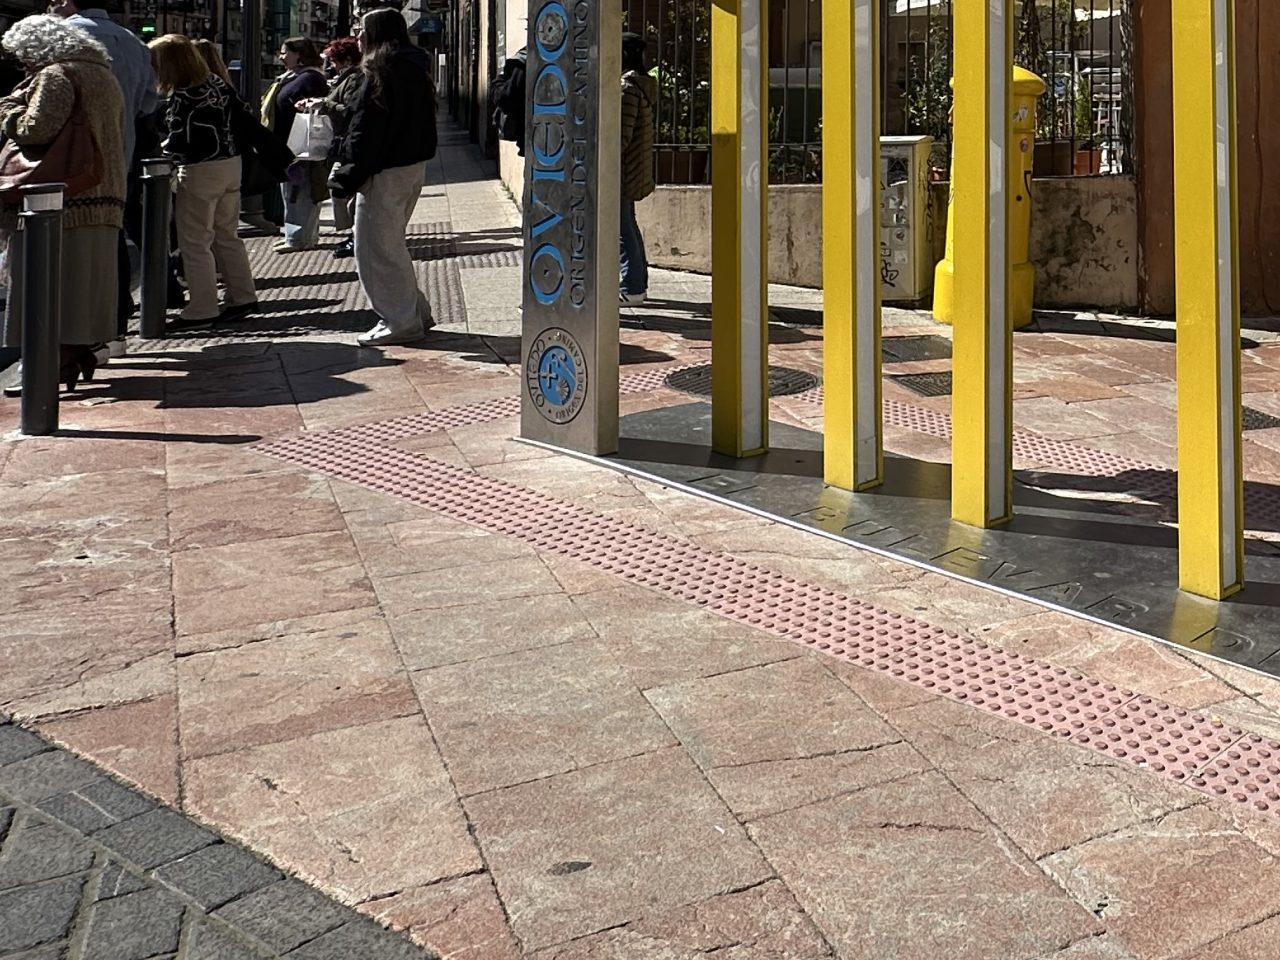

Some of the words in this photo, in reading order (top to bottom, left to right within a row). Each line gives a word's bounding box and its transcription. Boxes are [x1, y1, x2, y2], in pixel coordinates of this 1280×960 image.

[573, 0, 590, 126] CAMINO
[530, 1, 569, 305] OVIEDO
[571, 136, 588, 186] DEL
[569, 195, 588, 309] ORIGEN
[529, 339, 545, 407] OVIEDO
[790, 506, 1150, 620] BULEVAR
